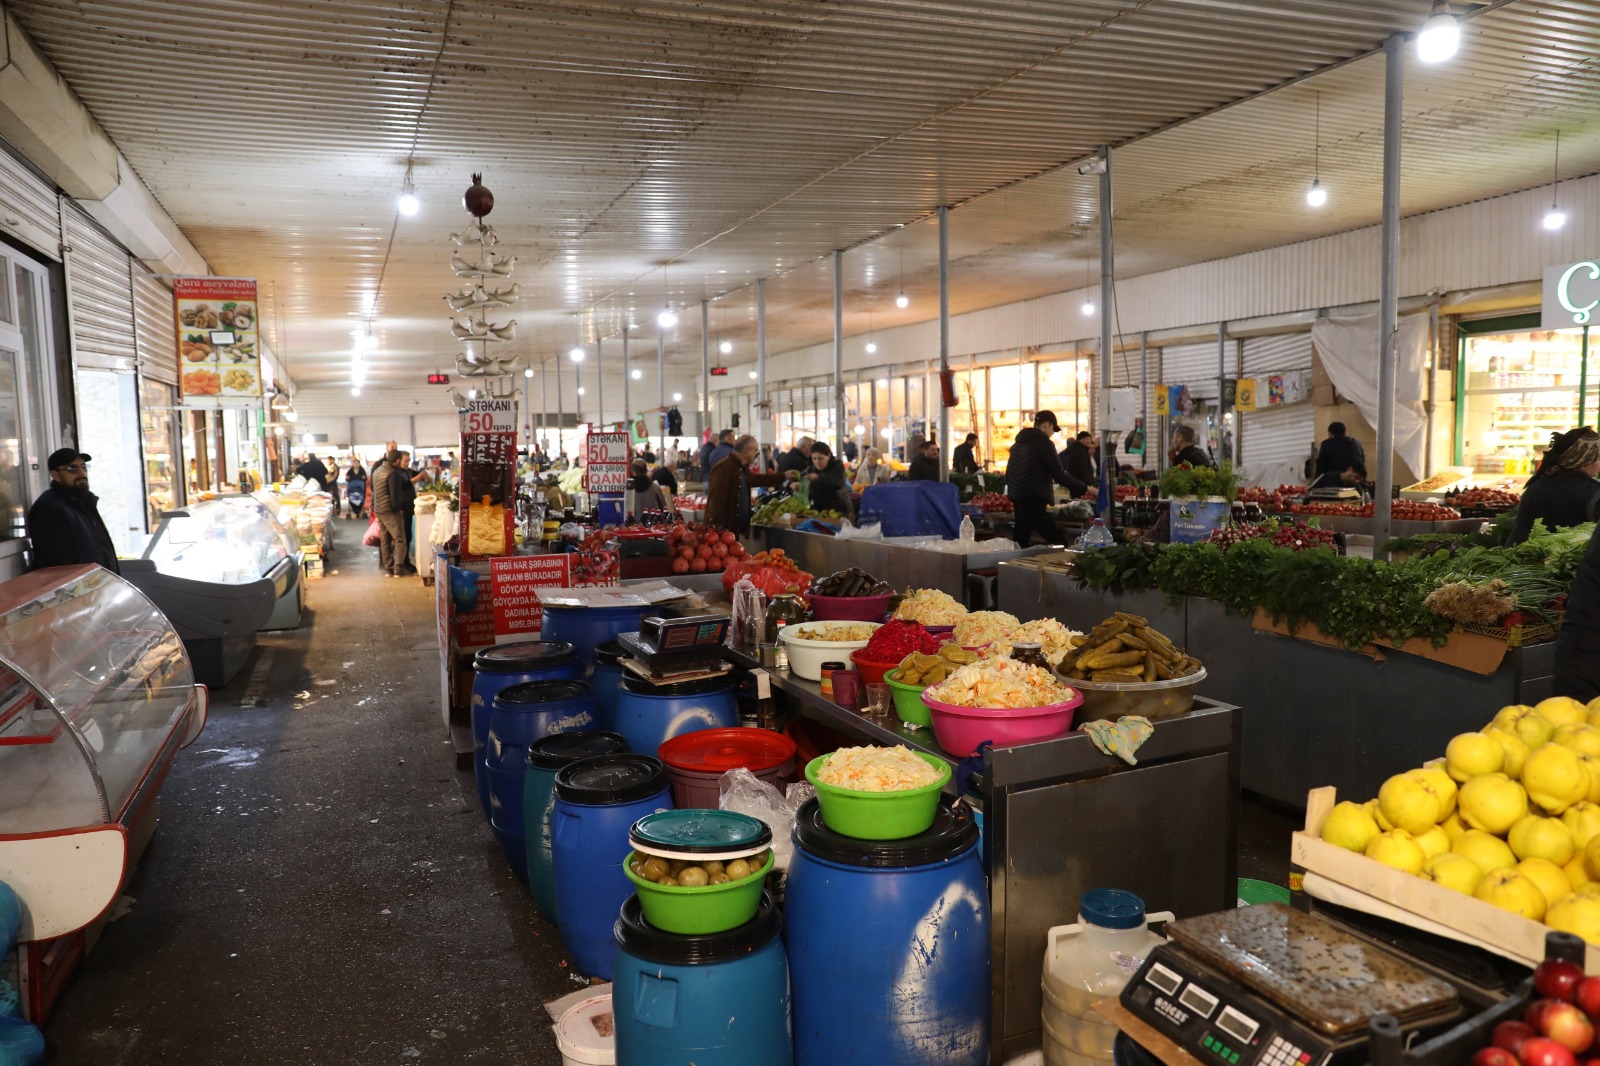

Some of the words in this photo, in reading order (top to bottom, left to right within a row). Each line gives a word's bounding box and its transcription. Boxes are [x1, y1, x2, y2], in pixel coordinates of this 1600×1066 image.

[469, 401, 511, 412] STƏKANI
[469, 412, 494, 432] 50
[590, 434, 626, 443] STƏKANI
[590, 444, 609, 463] 50
[590, 473, 626, 485] QANI
[591, 484, 626, 492] ARTIRIR
[513, 560, 528, 570] NAR
[529, 559, 564, 570] ŞƏRABININ
[497, 573, 523, 582] MƏKANI
[524, 570, 563, 580] BURADADIR
[500, 583, 528, 594] GÖYÇAY
[493, 595, 529, 607] GÖYÇAYDA
[505, 608, 529, 617] DADINA
